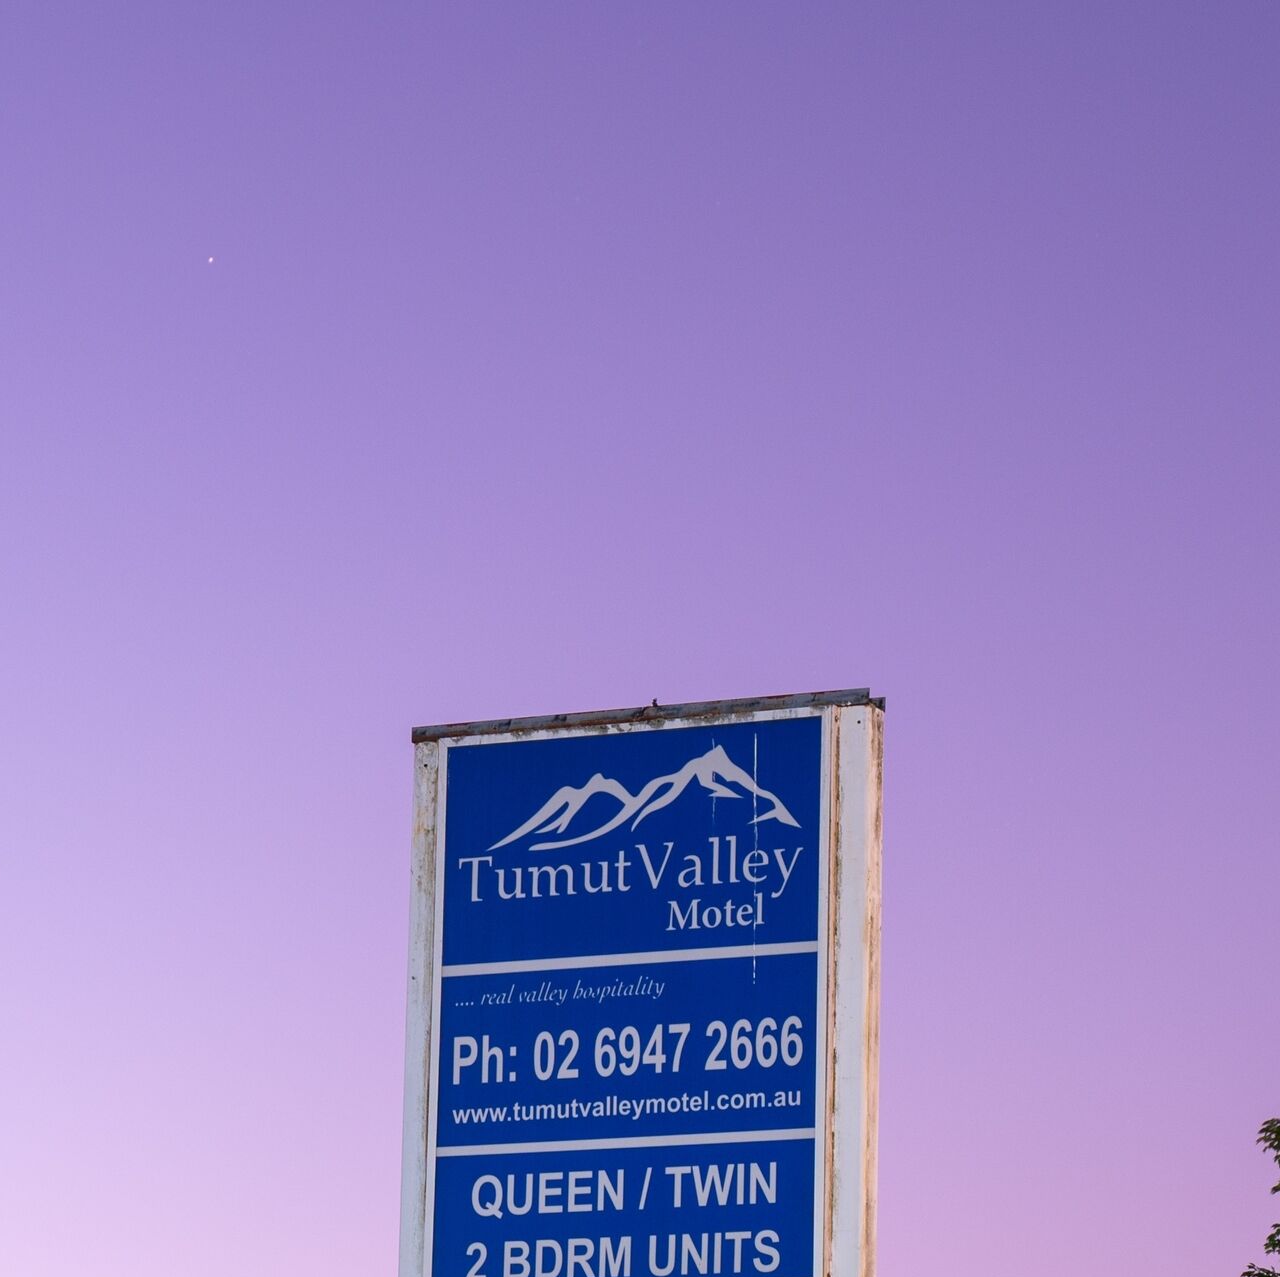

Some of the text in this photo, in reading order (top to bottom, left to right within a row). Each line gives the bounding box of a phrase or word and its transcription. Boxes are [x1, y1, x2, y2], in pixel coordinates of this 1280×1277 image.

[666, 893, 764, 931] Motel
[480, 981, 513, 1006] real
[519, 980, 568, 1006] valley
[573, 975, 665, 1004] hospitality
[452, 1015, 803, 1085] Ph: 02 6947 2666
[453, 1090, 801, 1124] www.tumutvalleymotel.com.au
[471, 1161, 777, 1219] QUEEN / TWIN
[649, 1229, 780, 1276] UNITS
